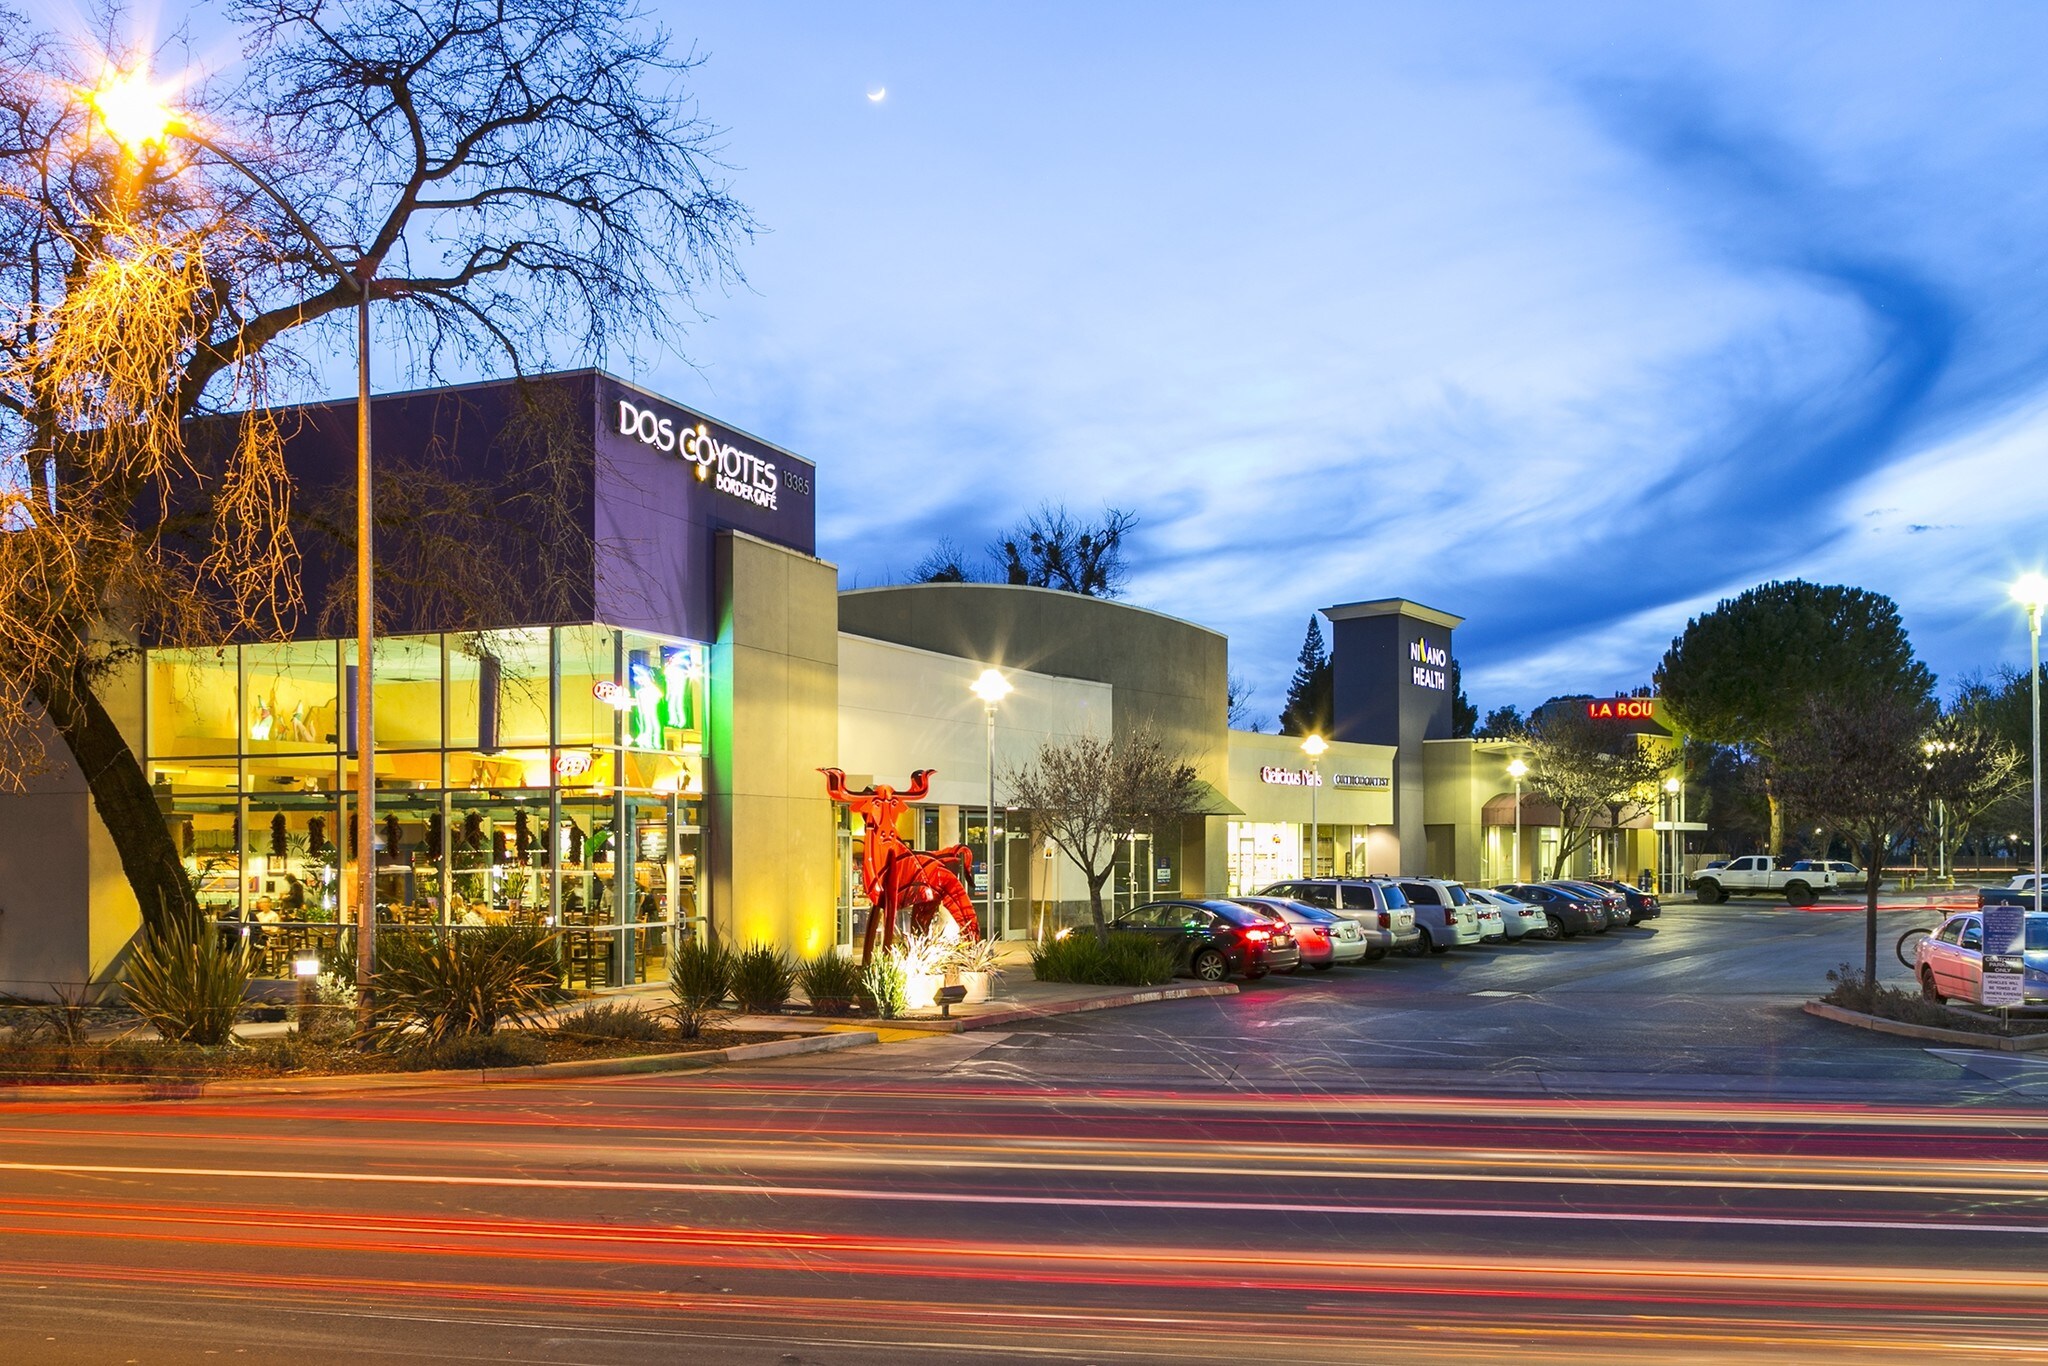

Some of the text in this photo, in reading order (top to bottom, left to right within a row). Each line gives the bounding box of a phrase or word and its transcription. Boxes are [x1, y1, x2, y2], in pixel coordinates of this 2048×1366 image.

[620, 401, 778, 491] DOS COYOTES
[716, 473, 754, 503] BORDER
[782, 470, 809, 495] 13385
[1410, 637, 1447, 668] NIVANO
[1413, 666, 1445, 690] HEALTH
[1617, 702, 1653, 717] BOU
[557, 758, 592, 774] OPEN
